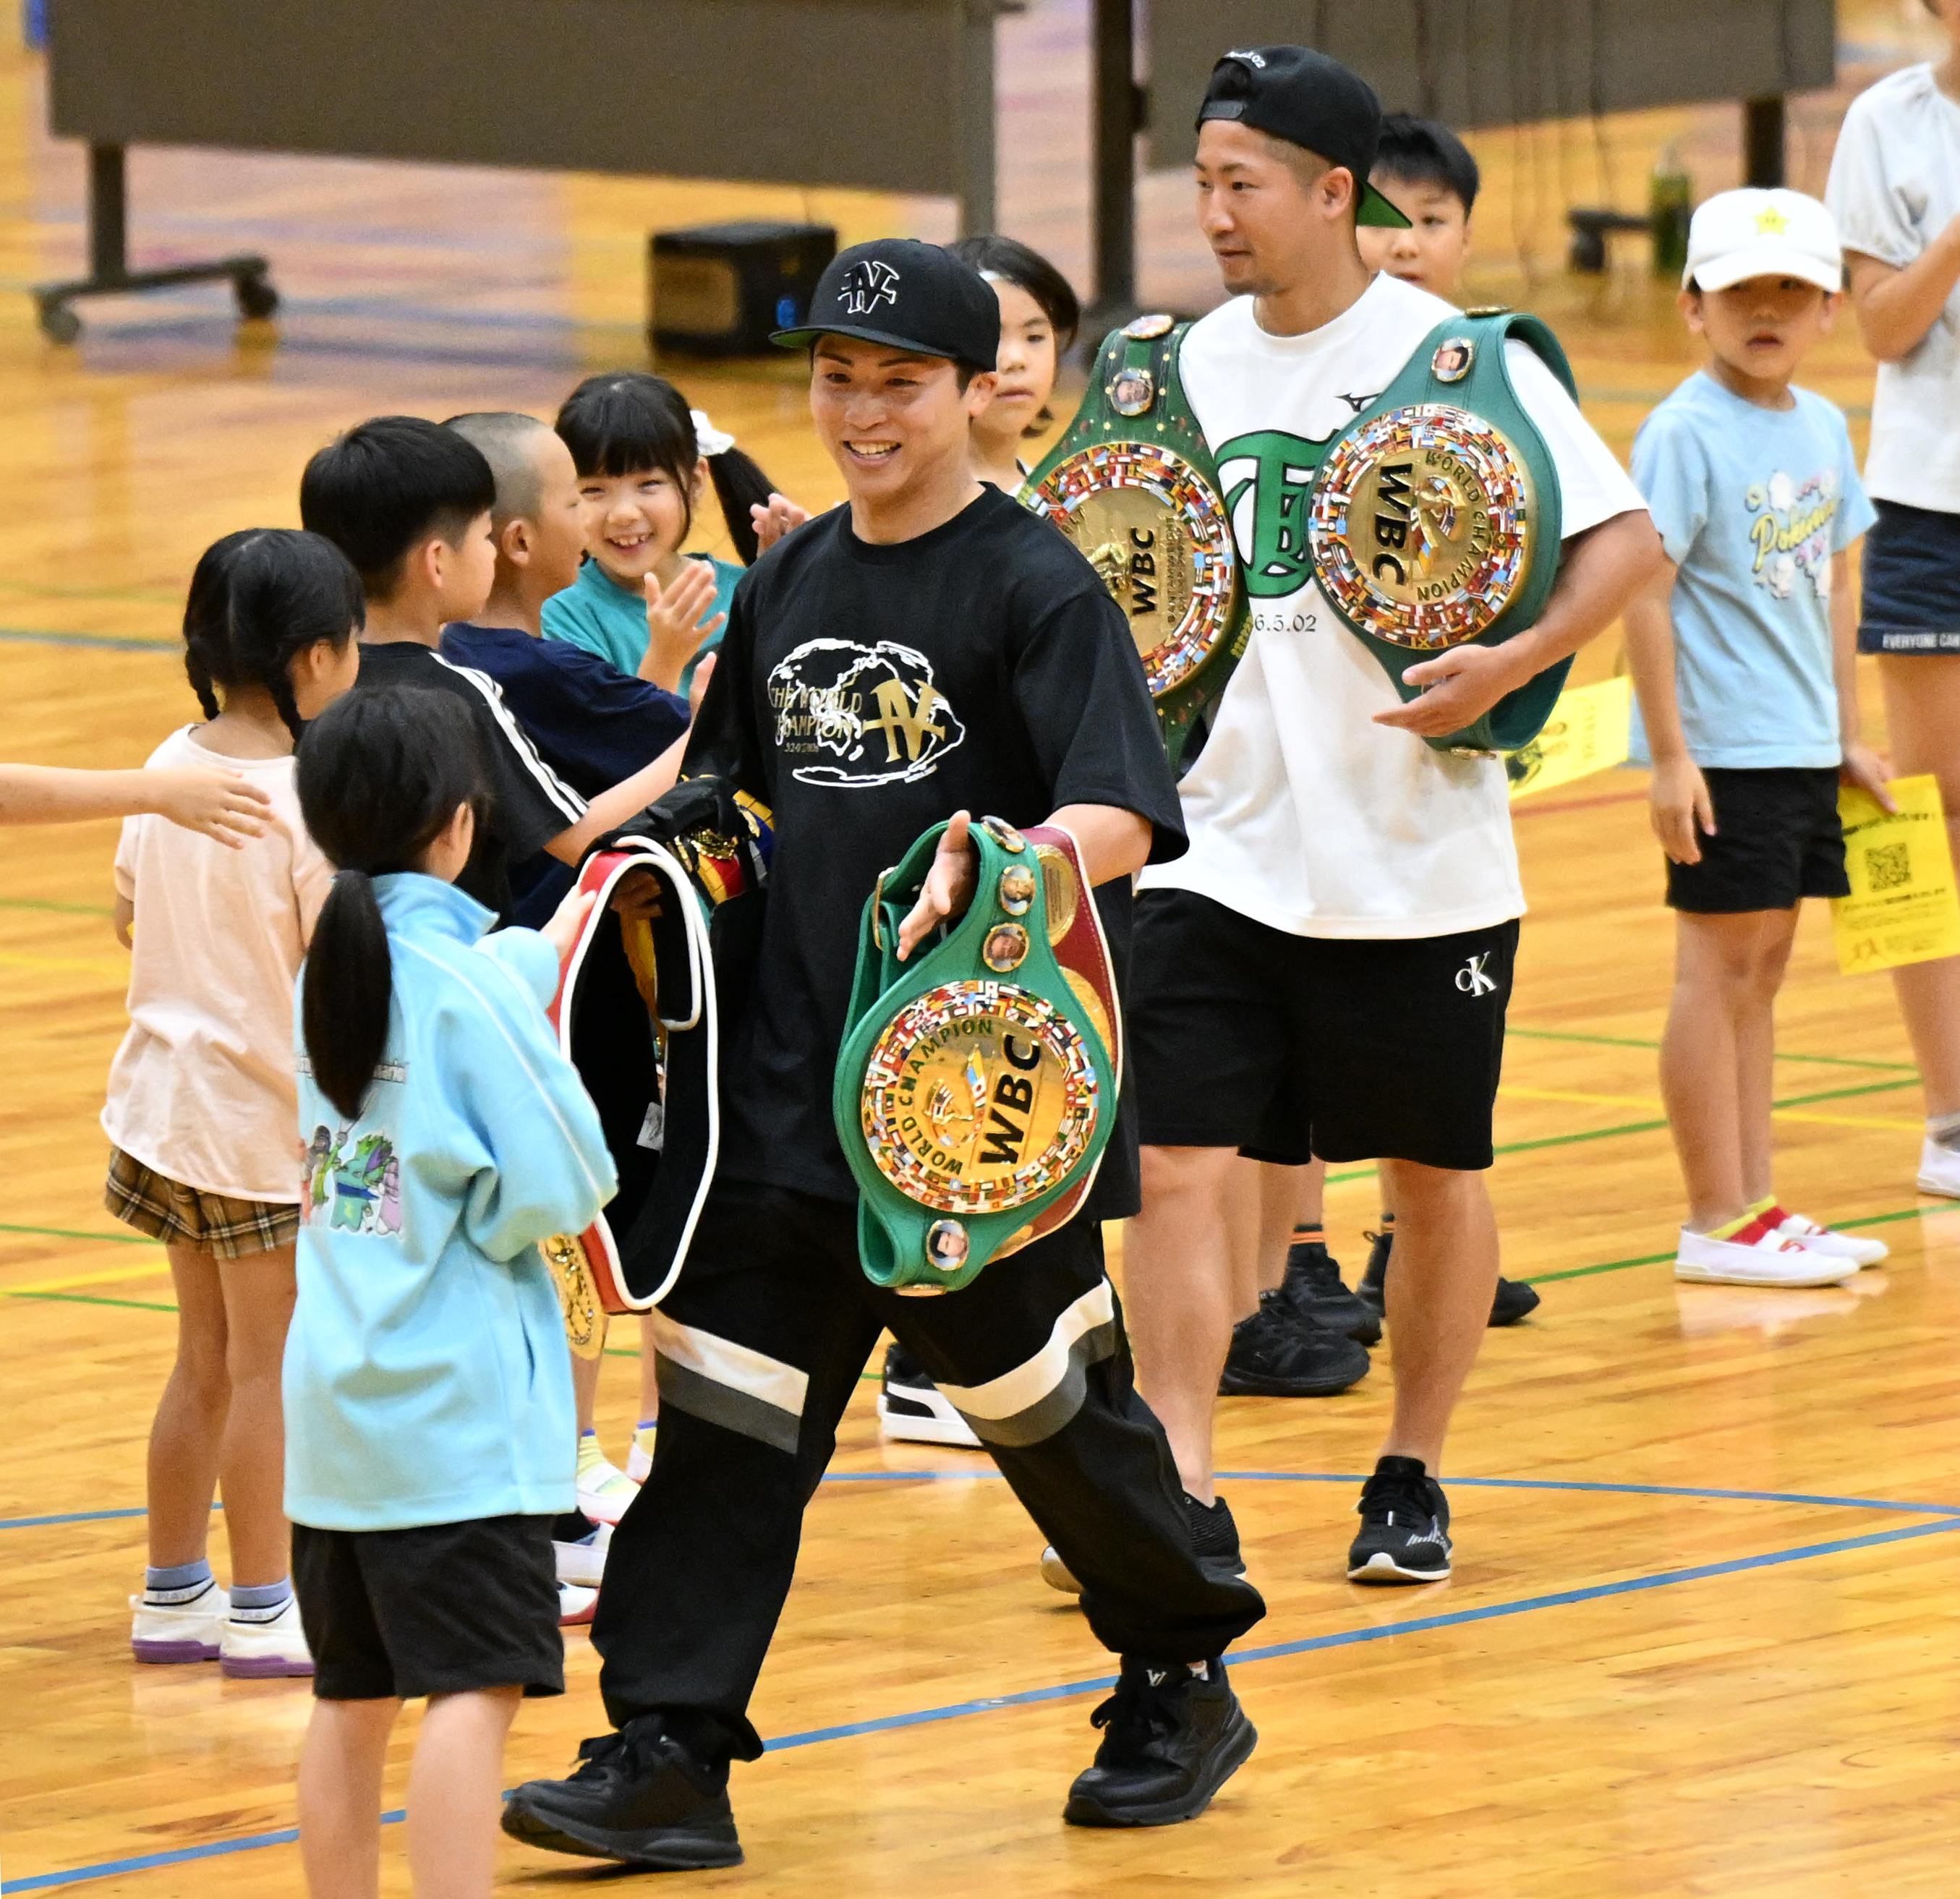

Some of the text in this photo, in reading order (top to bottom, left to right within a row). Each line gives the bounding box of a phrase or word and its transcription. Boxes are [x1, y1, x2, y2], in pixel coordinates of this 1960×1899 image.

[1130, 527, 1156, 615] WBC
[1372, 463, 1413, 586] WBC
[1416, 451, 1488, 602] WORLD CHAMPION
[773, 714, 853, 738] HAMPION
[898, 1018, 994, 1176] WORLD CHAMPION
[979, 1034, 1042, 1166] WBC
